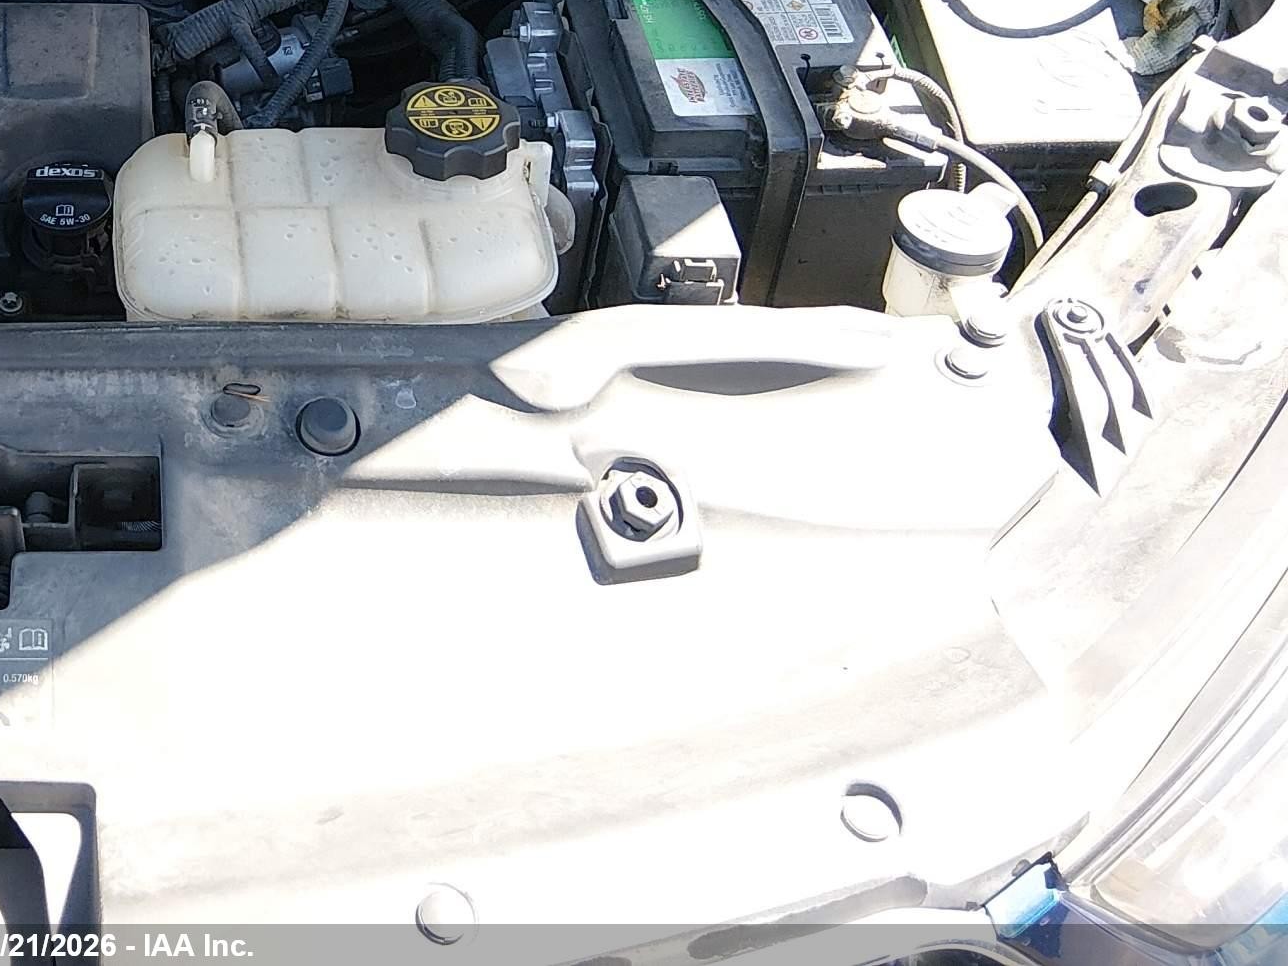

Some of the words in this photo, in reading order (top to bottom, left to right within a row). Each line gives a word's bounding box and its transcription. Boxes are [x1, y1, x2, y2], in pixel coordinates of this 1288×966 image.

[35, 166, 97, 177] dexos
[40, 214, 57, 225] SAE
[59, 214, 91, 226] 5W-30
[3, 673, 39, 685] 0.570kg
